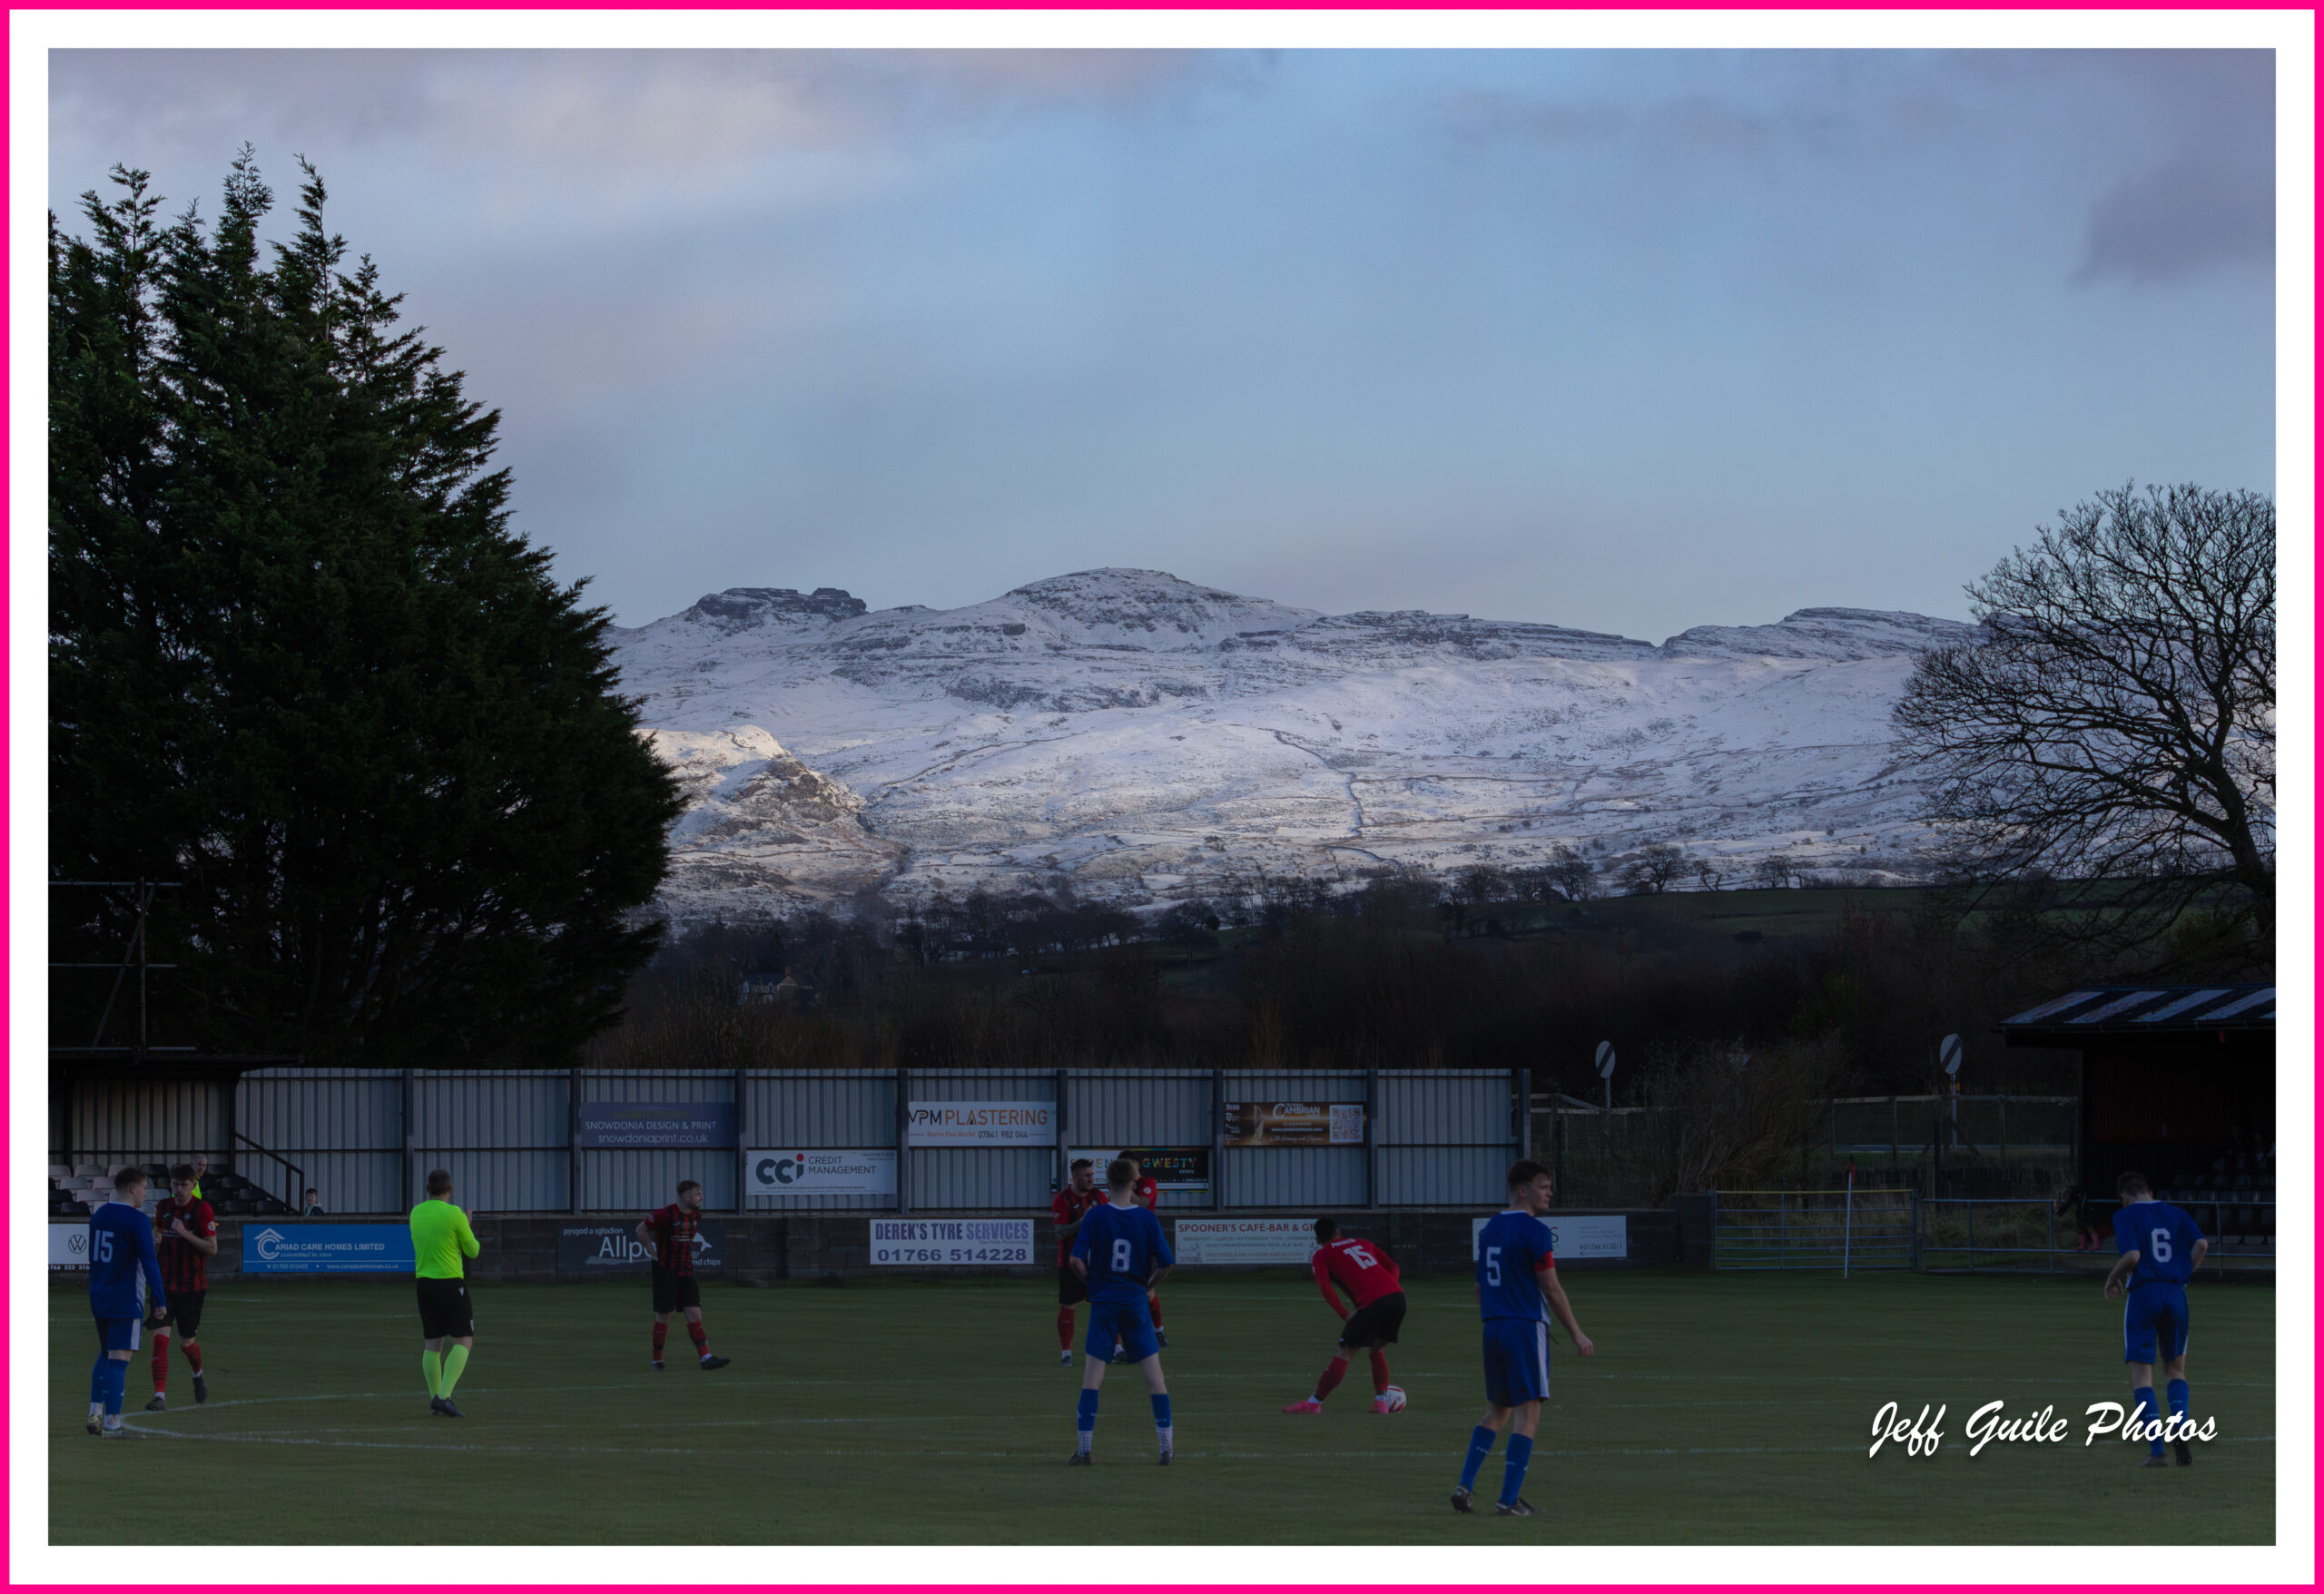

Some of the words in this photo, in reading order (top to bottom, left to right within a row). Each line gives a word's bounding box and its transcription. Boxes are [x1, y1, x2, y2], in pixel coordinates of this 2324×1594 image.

[1273, 1103, 1321, 1119] CAMBRIAN
[586, 1121, 644, 1130] SNOWDONIA
[646, 1121, 679, 1130] DESIGN
[682, 1121, 689, 1130] &
[692, 1121, 717, 1130] PRINT
[598, 1134, 708, 1145] snowdoniaprint.co.uk
[808, 1156, 842, 1165] CREDIT
[1142, 1157, 1196, 1168] GWESTY
[808, 1166, 877, 1175] MANAGEMENT
[563, 1227, 588, 1236] pysgod
[595, 1227, 624, 1236] sglodion
[931, 1223, 963, 1240] TYRE
[967, 1222, 1029, 1240] SERVICES
[1178, 1224, 1236, 1233] SPOONER'S
[1293, 1224, 1299, 1232] &
[93, 1229, 115, 1264] 15
[300, 1243, 323, 1251] CARE
[324, 1243, 353, 1251] HOMES
[354, 1243, 385, 1251] LIMITED
[2151, 1227, 2172, 1263] 6
[877, 1249, 942, 1262] 01766
[950, 1249, 1027, 1262] 514228
[1111, 1238, 1132, 1273] 8
[1344, 1245, 1378, 1270] 15
[704, 1258, 722, 1266] chips
[1486, 1246, 1502, 1287] 5
